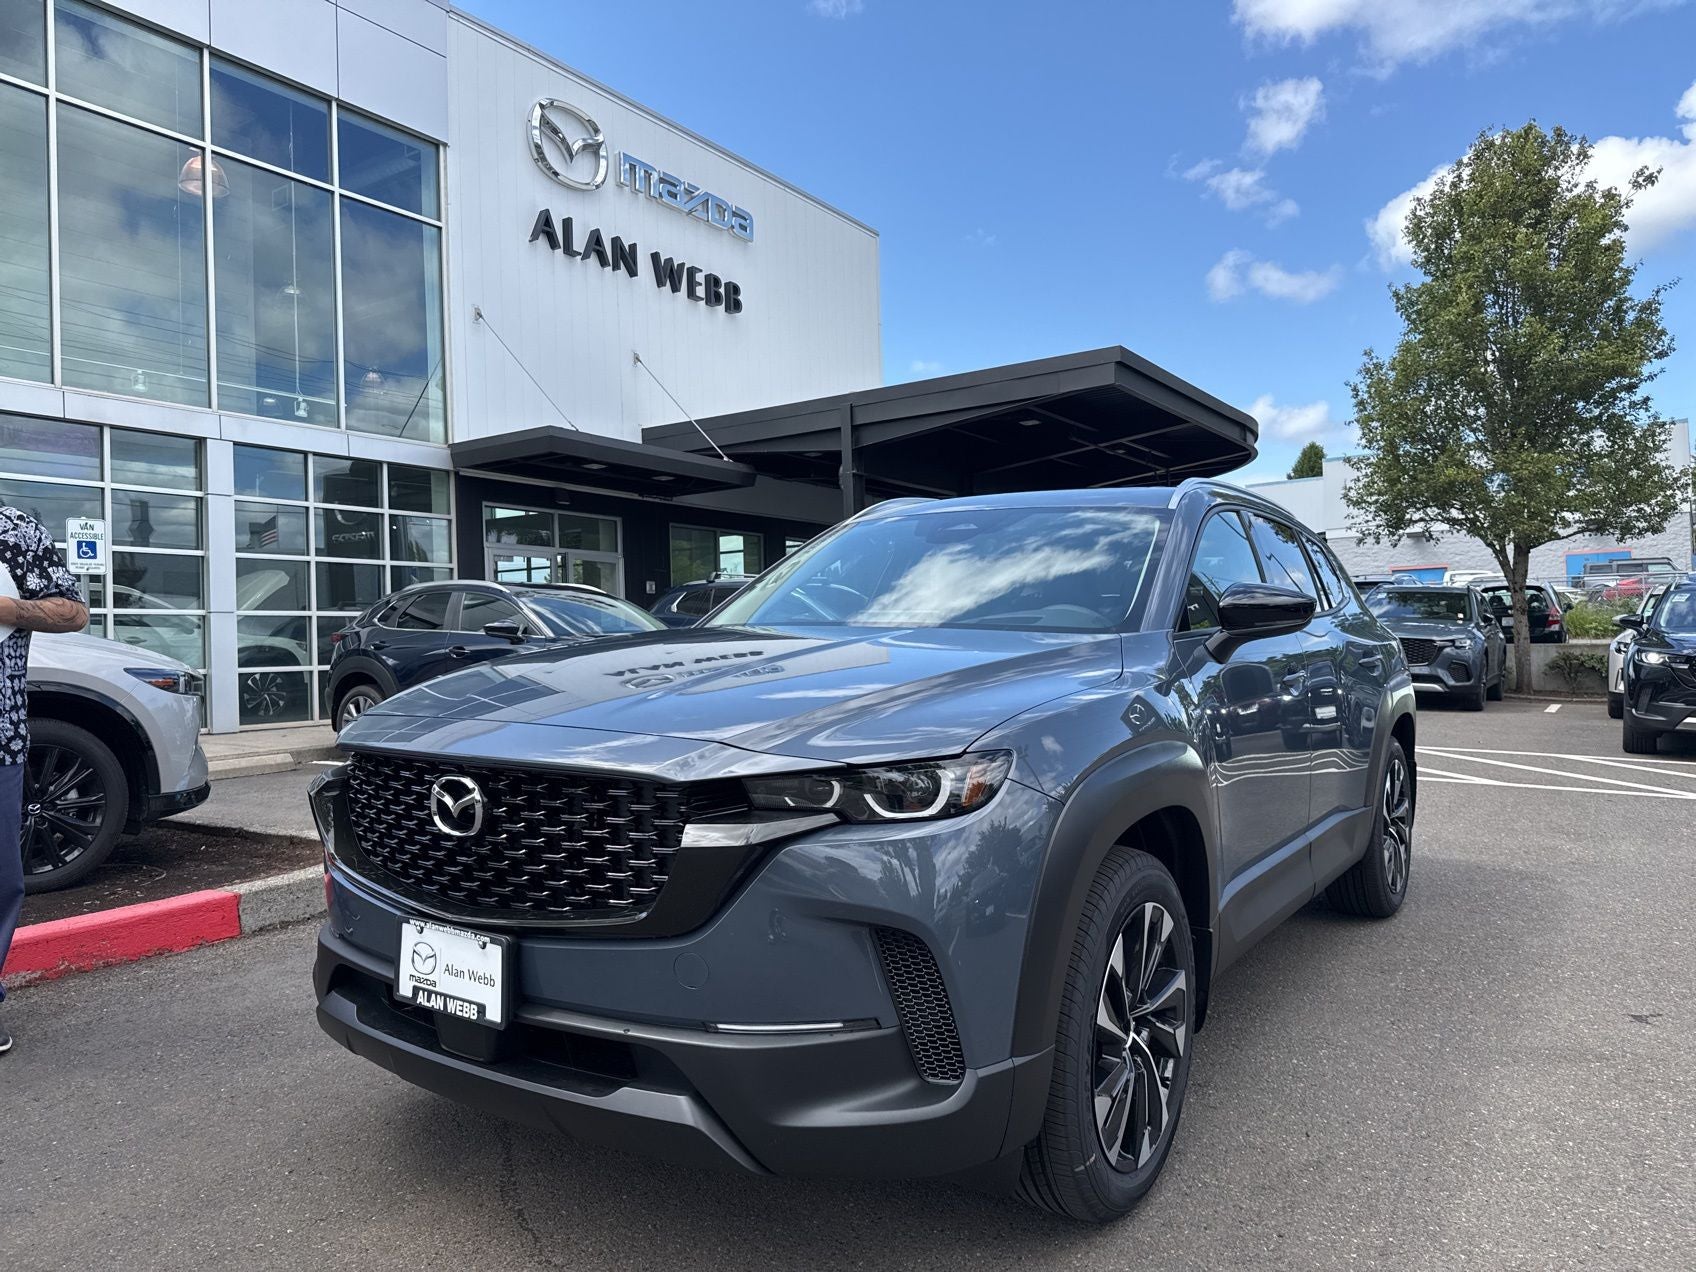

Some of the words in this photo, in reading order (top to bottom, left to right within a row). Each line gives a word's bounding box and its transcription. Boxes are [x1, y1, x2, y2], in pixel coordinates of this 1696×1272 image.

[615, 151, 754, 242] mazda
[529, 208, 638, 278] ALAN
[650, 251, 743, 314] WEBB
[70, 532, 104, 540] ACCESSIBLE
[80, 522, 94, 531] VAN
[409, 974, 437, 988] mazda
[443, 963, 465, 979] Alan
[468, 969, 495, 987] Webb
[417, 990, 444, 1010] ALAN
[447, 997, 478, 1020] WEBB
